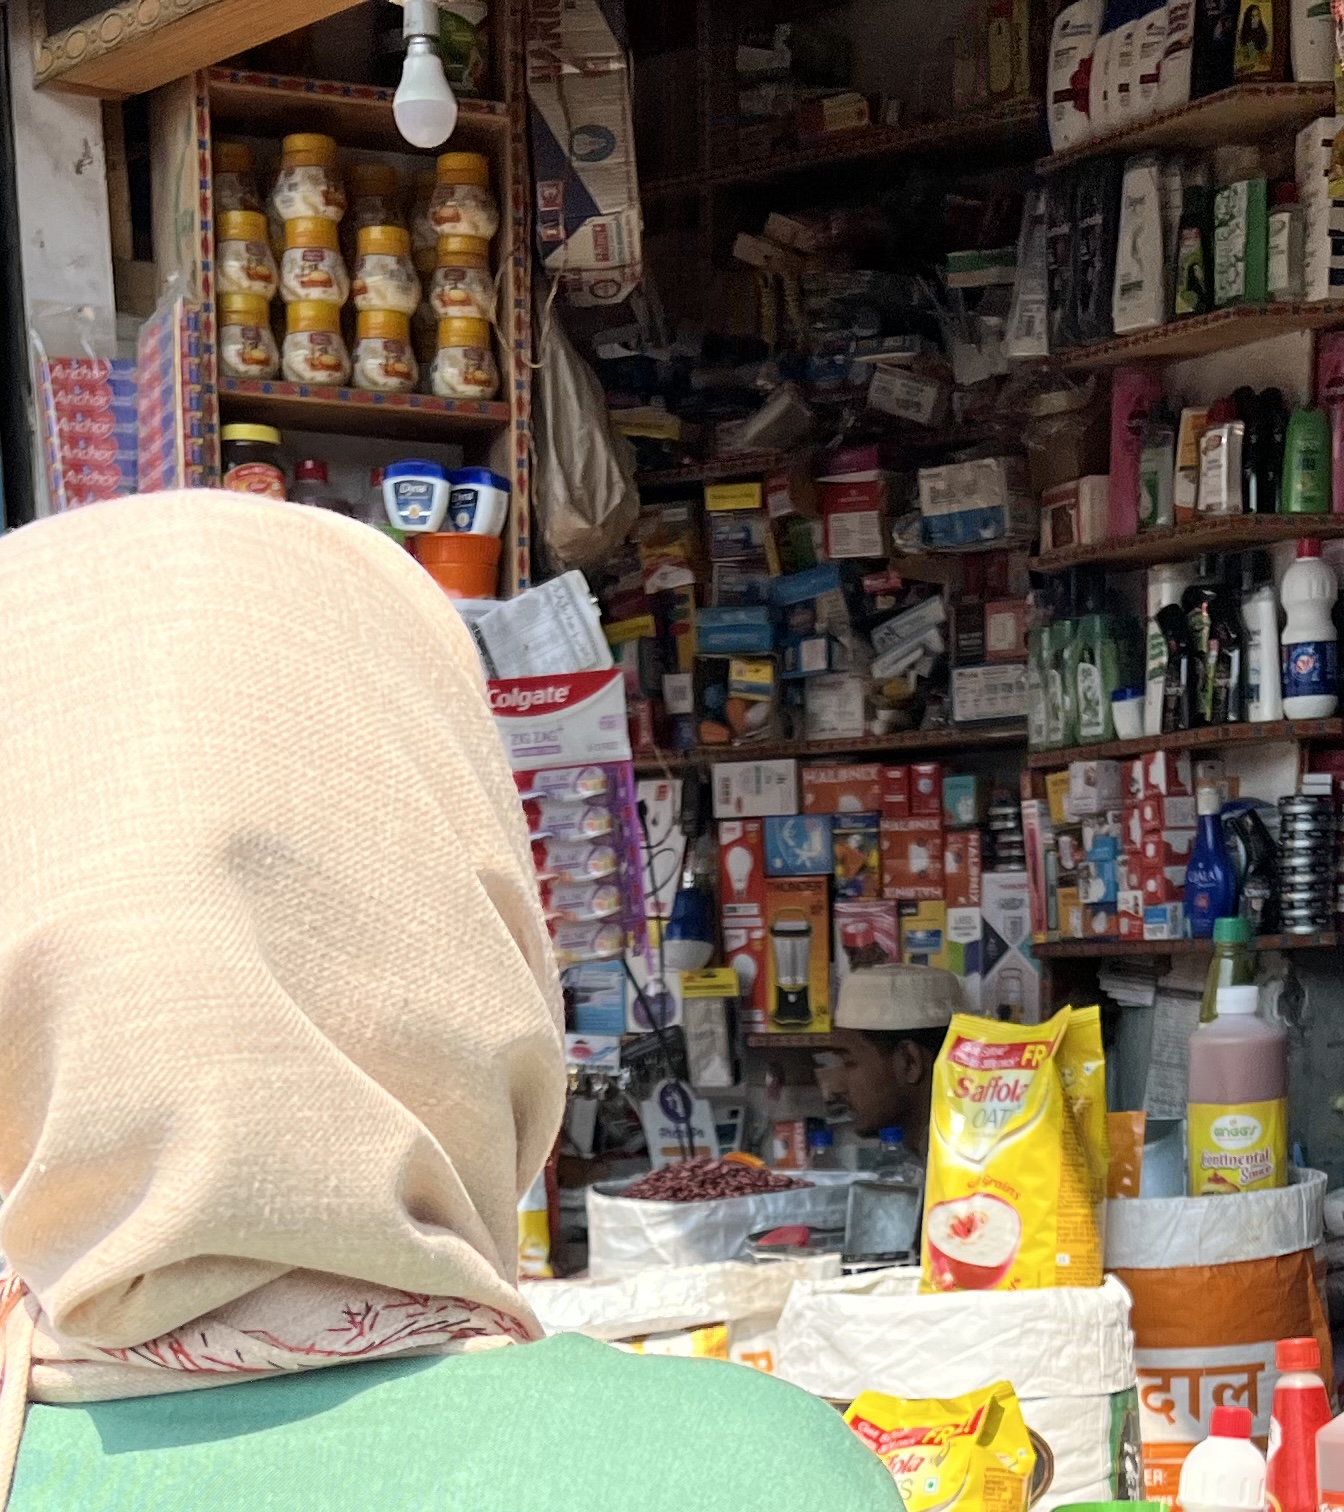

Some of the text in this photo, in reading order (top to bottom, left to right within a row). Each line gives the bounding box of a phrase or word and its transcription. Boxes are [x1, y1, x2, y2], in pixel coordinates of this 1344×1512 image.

[488, 684, 570, 710] Colgate
[1022, 1044, 1048, 1067] FR
[972, 1108, 1011, 1129] OAT
[1201, 1147, 1272, 1170] Continental
[1138, 1362, 1265, 1425] दाल
